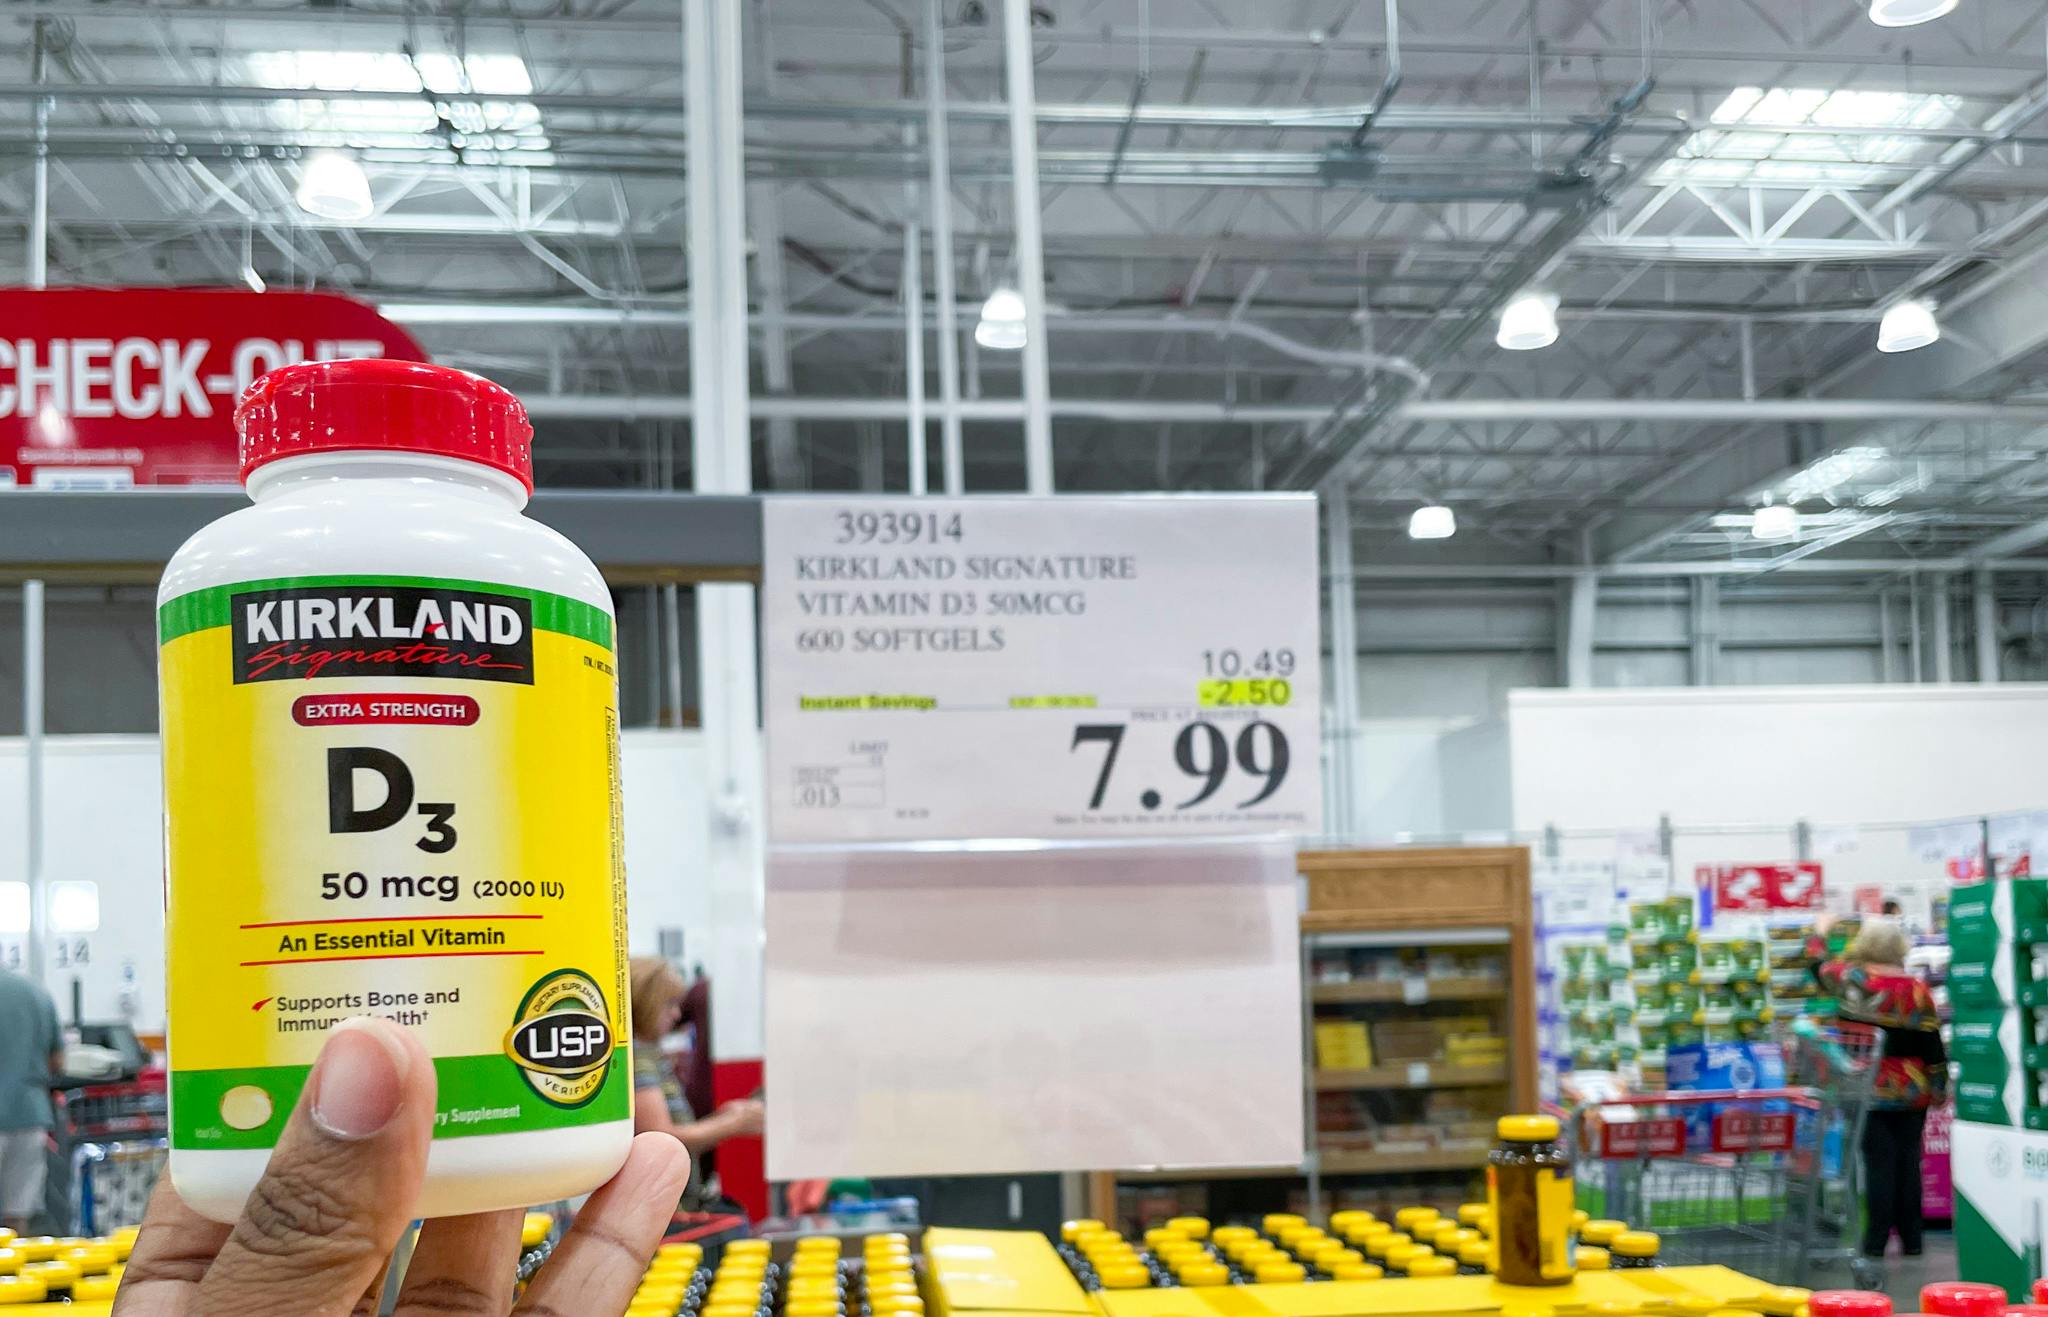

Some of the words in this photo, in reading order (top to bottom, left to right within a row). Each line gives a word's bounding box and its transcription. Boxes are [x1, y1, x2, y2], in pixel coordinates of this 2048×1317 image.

[835, 511, 963, 544] 393914
[795, 556, 956, 580] KIRKLAND
[964, 555, 1137, 580] SIGNATURE
[798, 592, 930, 616] VITAMIN
[940, 592, 978, 616] D3
[986, 591, 1086, 616] 50MCG
[247, 596, 524, 647] KIRKLAND
[796, 629, 845, 652] 600
[853, 627, 1006, 652] SOFTGELS
[247, 641, 525, 681] Signature
[1202, 649, 1295, 677] 10.49
[800, 695, 861, 709] Instant
[867, 694, 937, 712] Savings
[1201, 679, 1290, 706] -2.50
[305, 703, 365, 719] EXTRA
[370, 703, 466, 719] STRENGTH
[1071, 720, 1290, 810] 7.99
[327, 746, 457, 854] D3
[321, 872, 368, 900] 50
[382, 876, 459, 902] mcg
[473, 881, 535, 899] (2000
[541, 882, 564, 900] IU)
[279, 935, 307, 953] An
[314, 930, 414, 950] Essential
[422, 927, 505, 946] Vitamin
[277, 994, 362, 1012] Supports
[368, 991, 418, 1007] Bone
[424, 988, 460, 1004] and
[528, 1025, 605, 1059] USP
[544, 1073, 598, 1095] VERIFIED
[451, 1105, 520, 1124] Supplement
